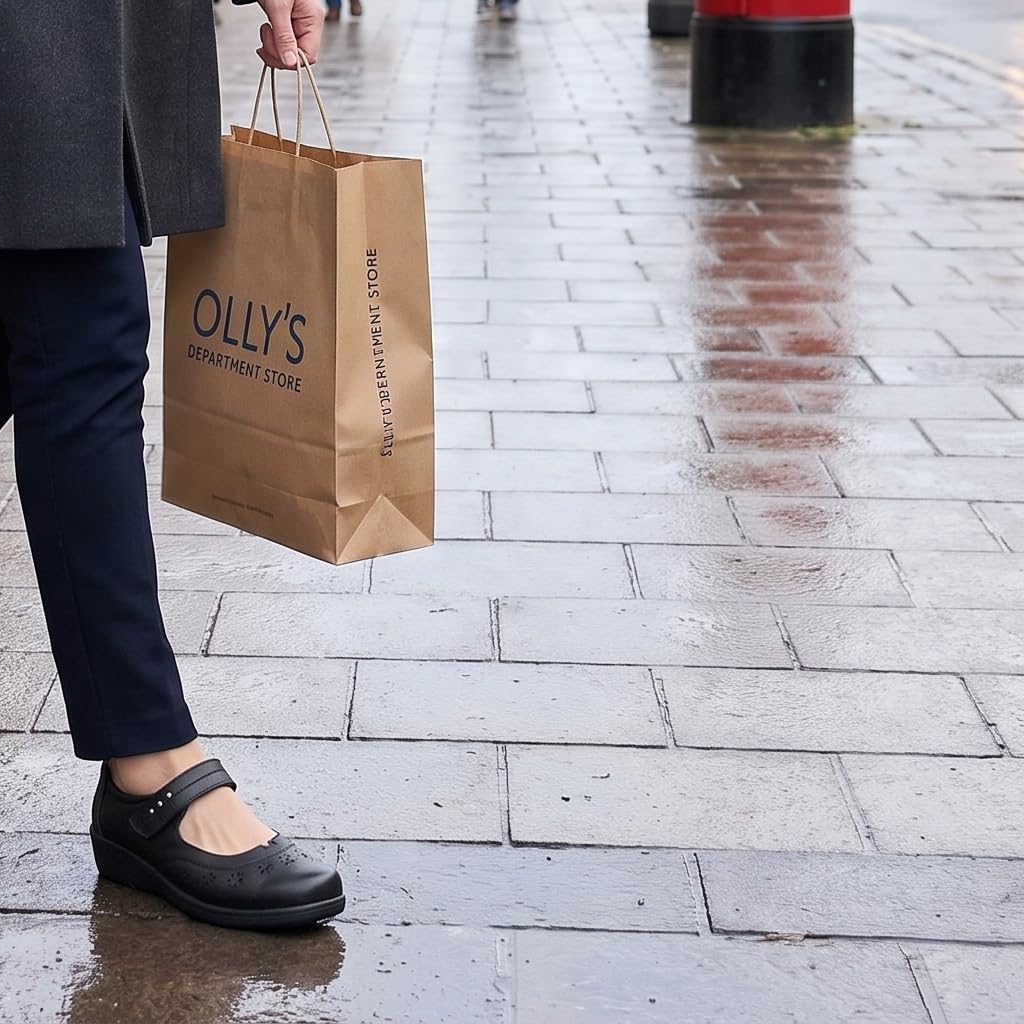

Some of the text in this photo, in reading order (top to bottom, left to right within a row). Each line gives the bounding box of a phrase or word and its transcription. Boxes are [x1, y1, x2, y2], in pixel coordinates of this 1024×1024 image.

[366, 248, 380, 299] STORE
[193, 288, 307, 365] OLLY'S
[187, 343, 302, 393] DEPARTMENT STORE
